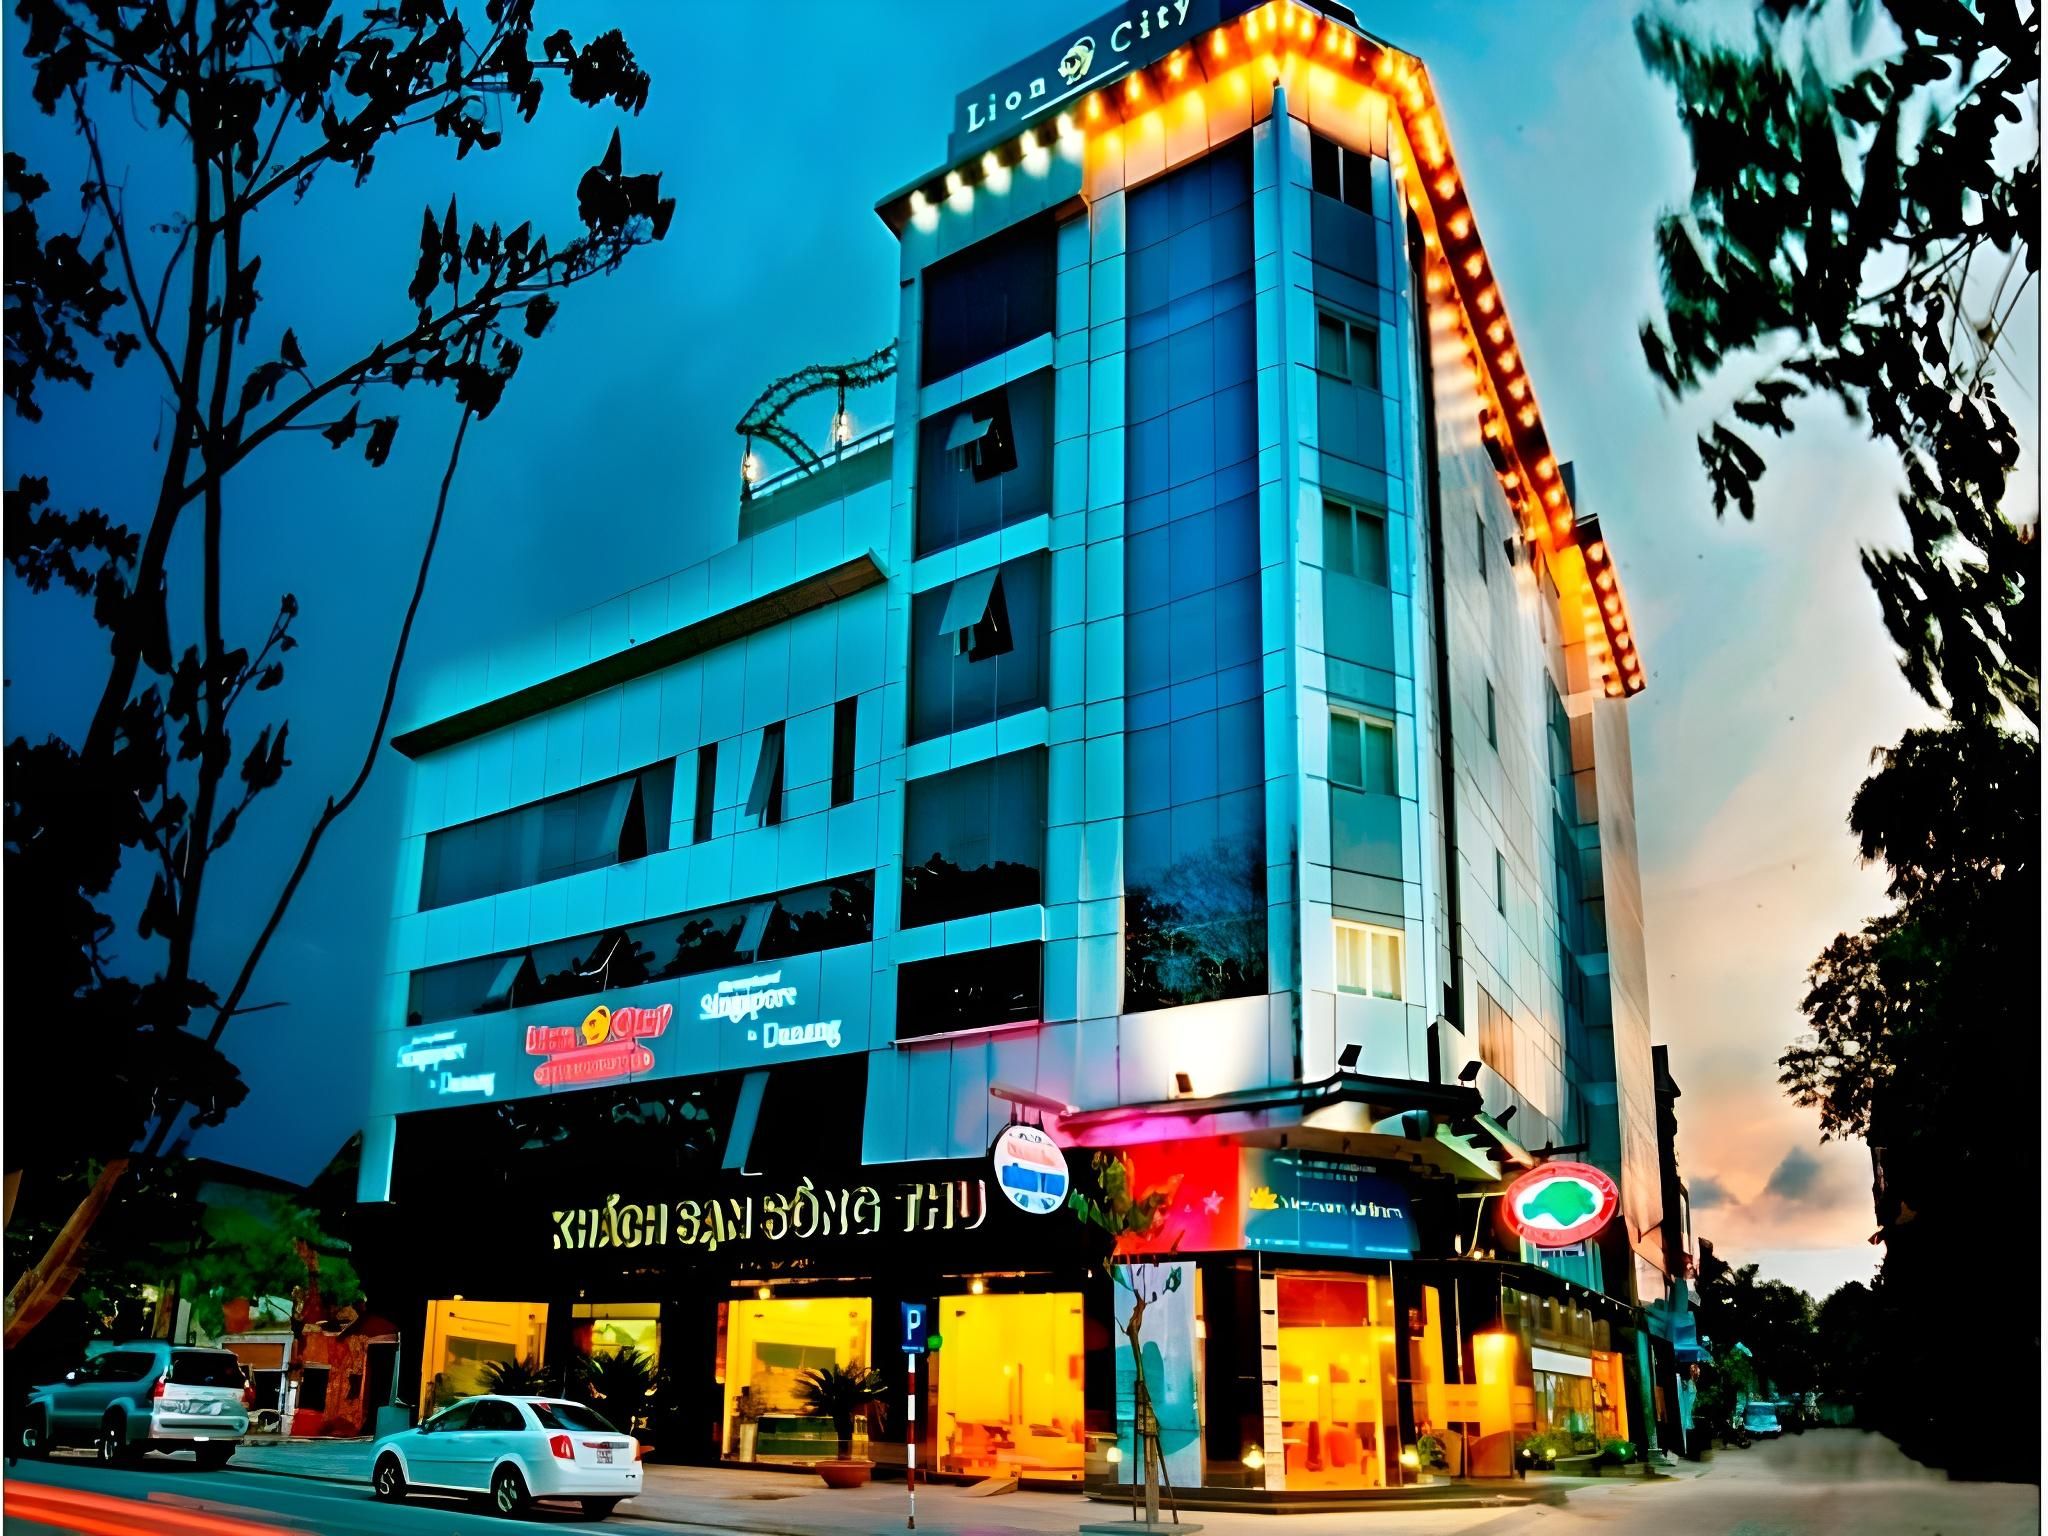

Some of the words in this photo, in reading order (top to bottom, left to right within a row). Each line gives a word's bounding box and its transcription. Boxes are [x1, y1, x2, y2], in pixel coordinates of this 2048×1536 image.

[966, 77, 1047, 134] Lion
[1110, 0, 1190, 53] City
[551, 1192, 669, 1250] KHÁCH
[894, 1178, 987, 1233] THU
[907, 1309, 921, 1341] P
